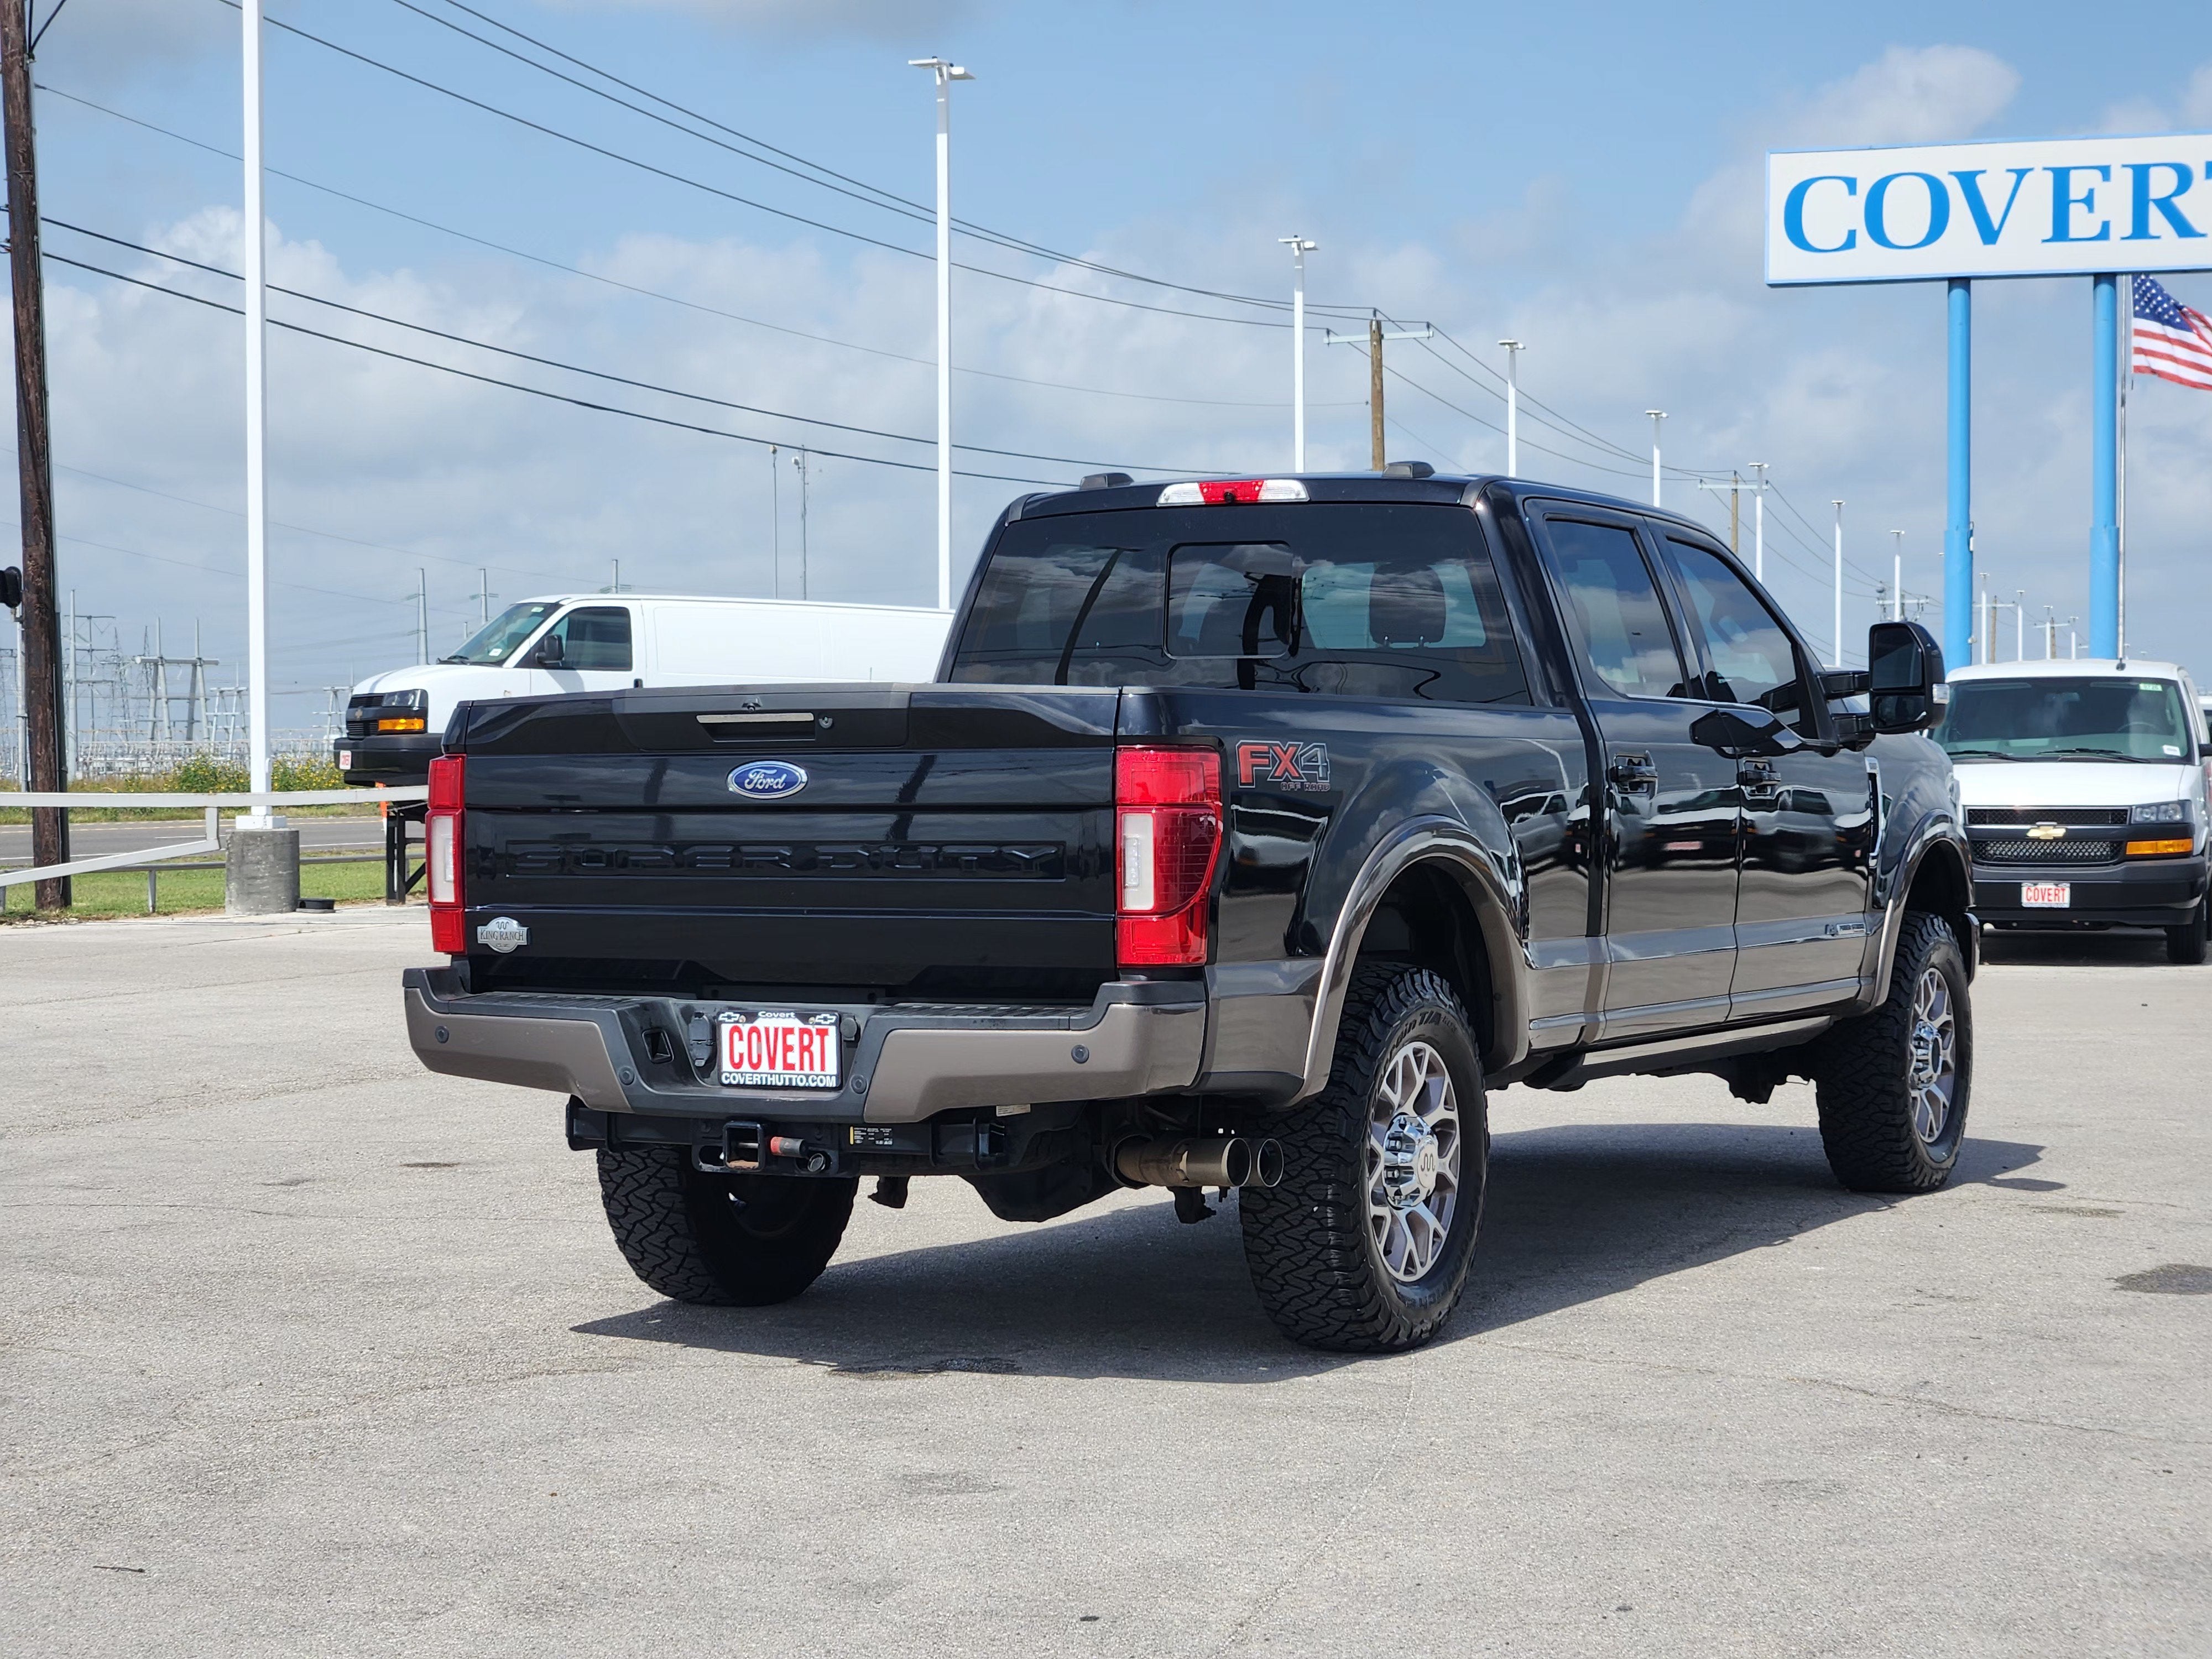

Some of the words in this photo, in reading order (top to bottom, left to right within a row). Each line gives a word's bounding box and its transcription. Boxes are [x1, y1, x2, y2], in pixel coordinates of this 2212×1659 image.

[1783, 161, 2212, 253] COVER
[1236, 740, 1330, 787] FX4
[744, 768, 787, 790] Ford
[1280, 782, 1301, 791] OFF
[1304, 782, 1331, 792] ROAD
[2026, 886, 2066, 902] COVERT
[479, 929, 498, 941] KING
[499, 931, 524, 941] RANCH
[728, 1025, 830, 1072] COVERT
[721, 1072, 837, 1088] COVERTHUTTO.COM
